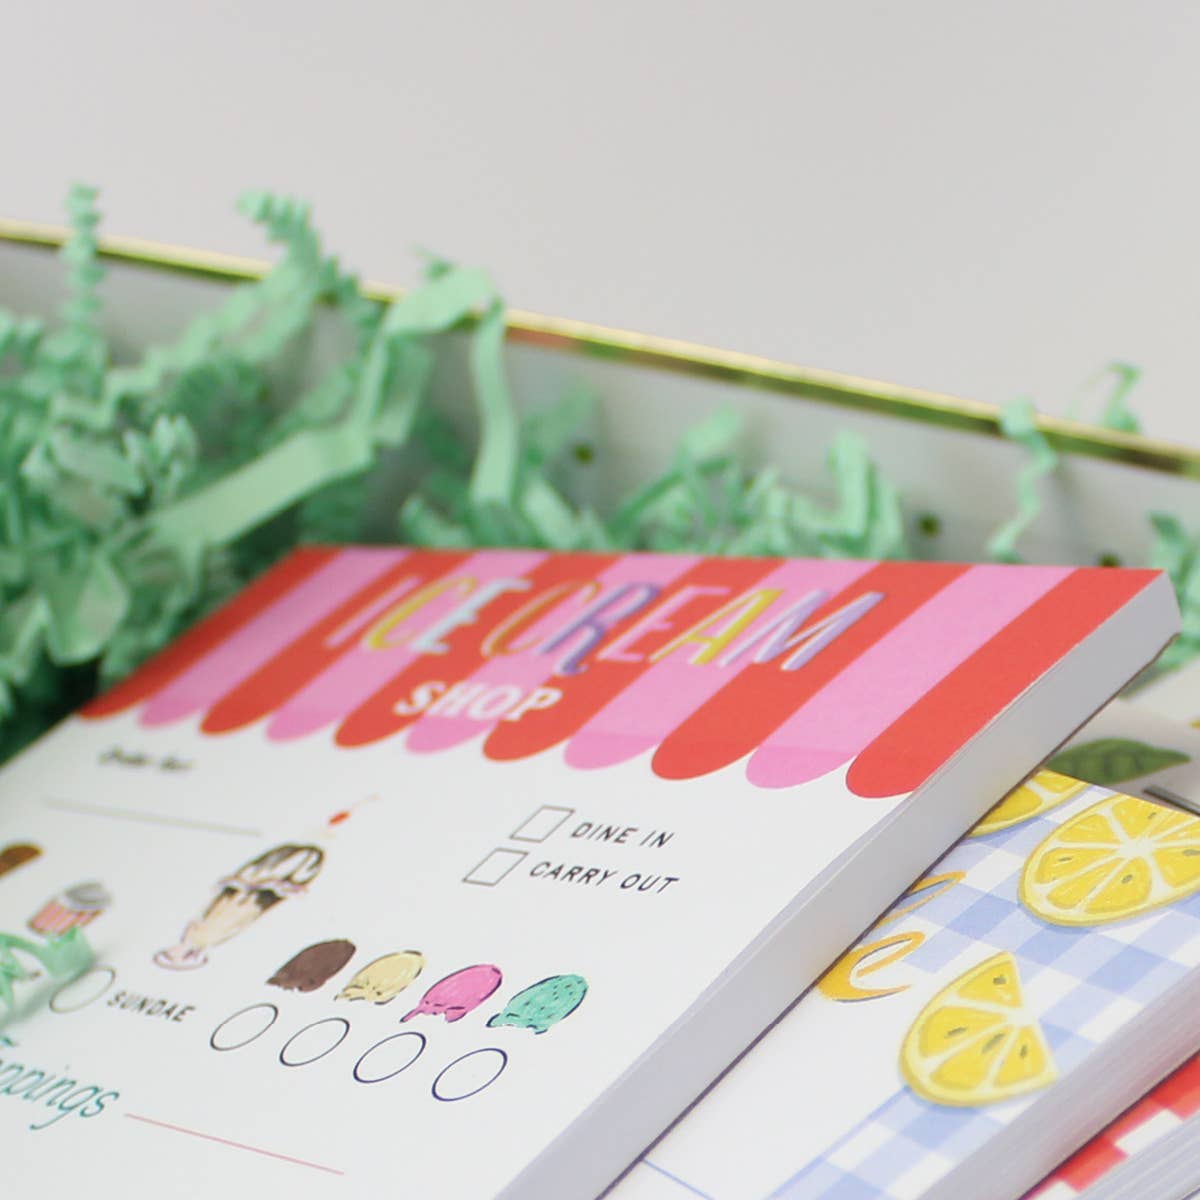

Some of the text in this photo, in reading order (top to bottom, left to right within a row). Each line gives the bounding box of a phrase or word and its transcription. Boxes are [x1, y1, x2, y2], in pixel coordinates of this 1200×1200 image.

[323, 574, 886, 676] ICE CREAM
[393, 680, 563, 722] SHOP
[570, 821, 675, 849] DINE IN
[529, 860, 680, 894] CARRY OUT
[106, 990, 197, 1023] SUNDAE
